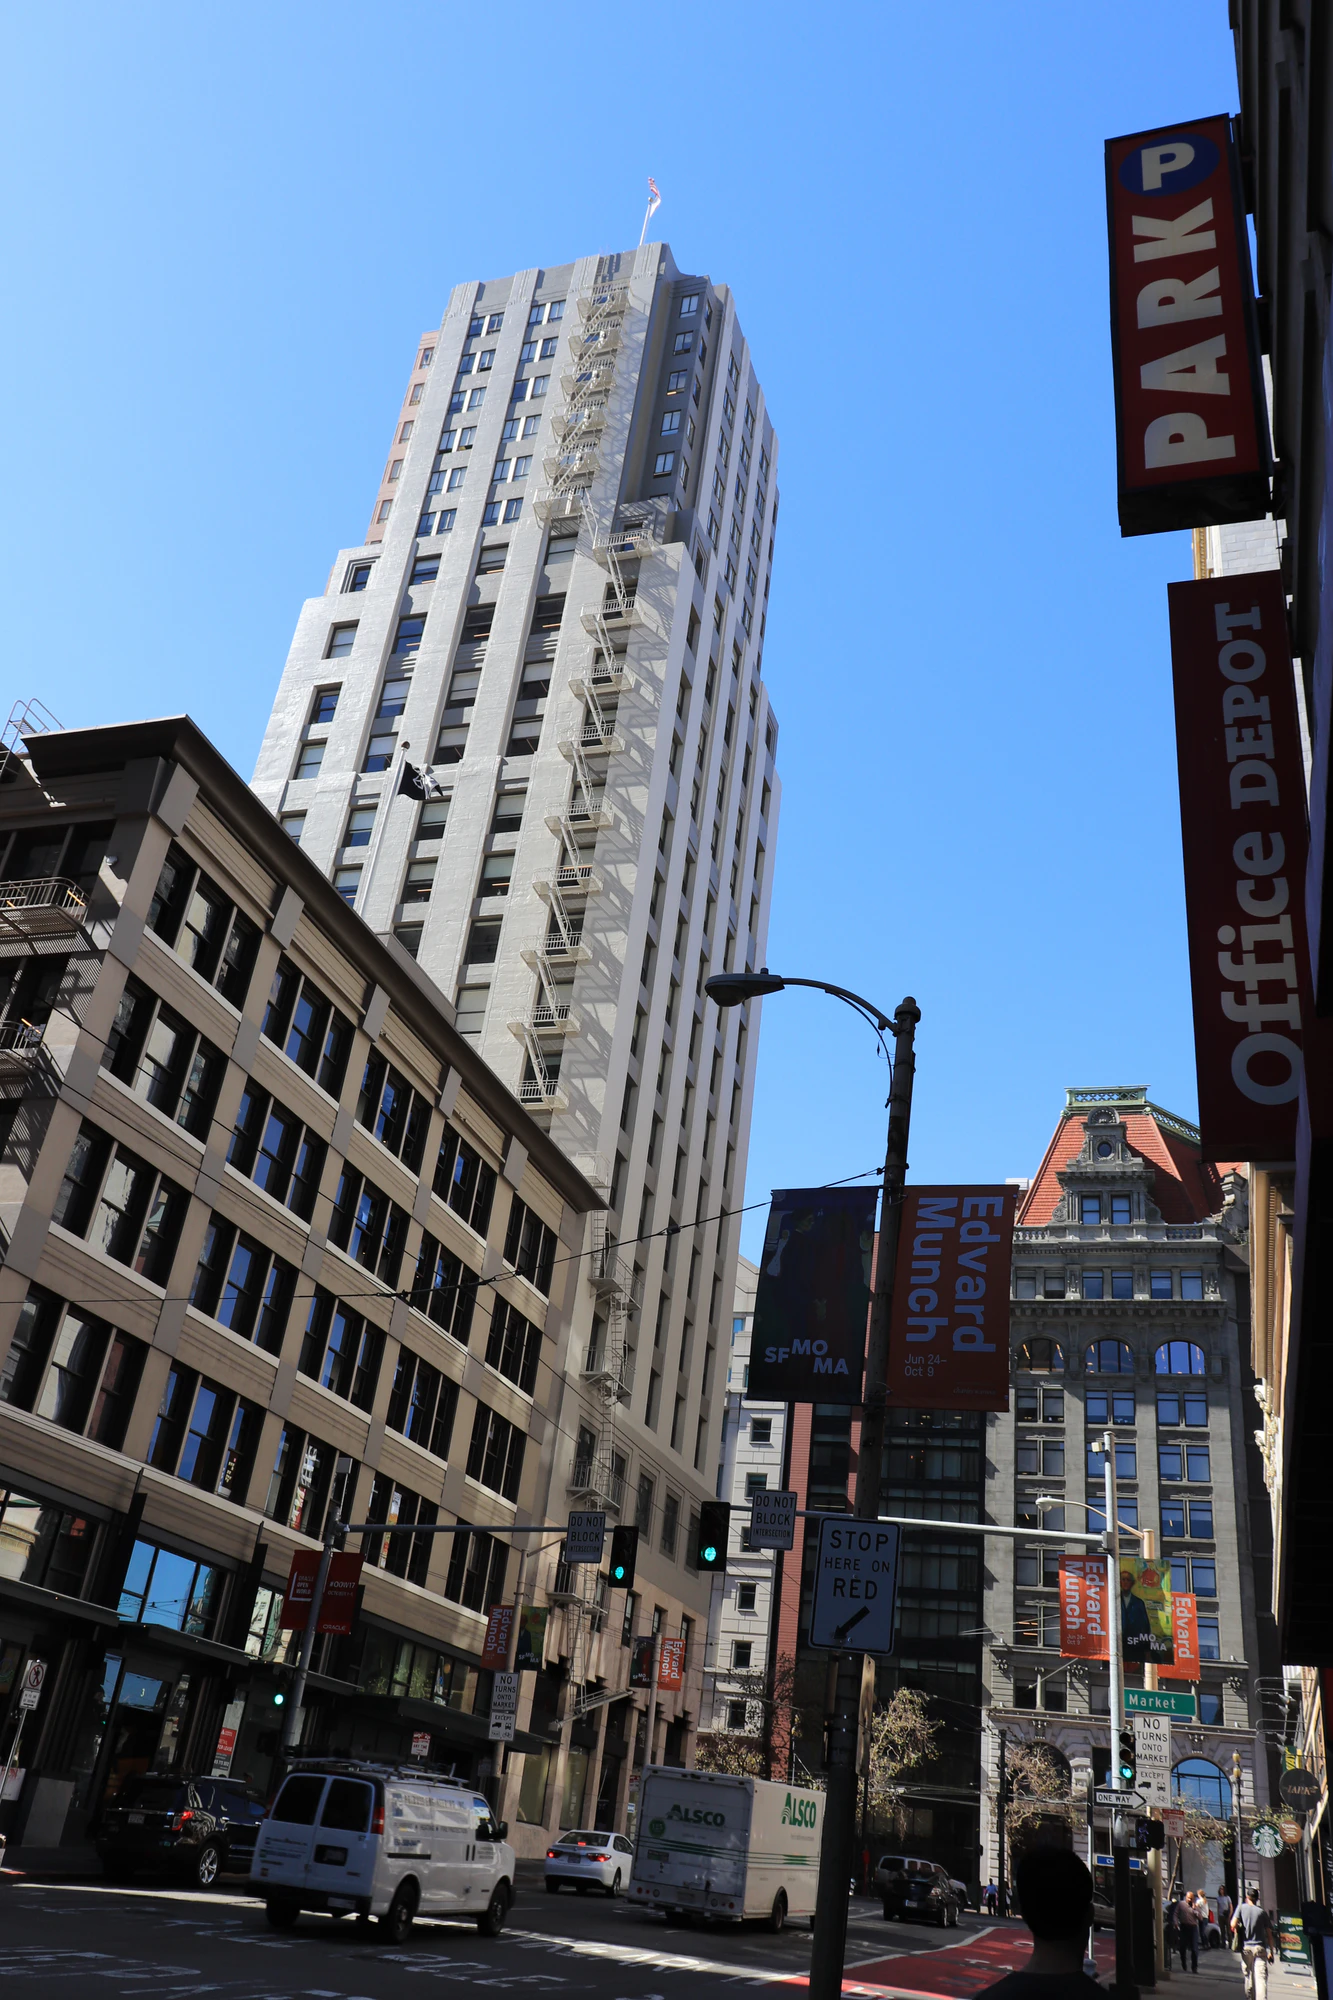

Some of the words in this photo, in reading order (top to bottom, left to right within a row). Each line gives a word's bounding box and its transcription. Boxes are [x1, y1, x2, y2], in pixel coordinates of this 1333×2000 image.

[1141, 142, 1195, 191] P
[1131, 197, 1236, 469] PARK
[1214, 602, 1280, 810] DEPOT
[1217, 831, 1304, 1105] Office
[906, 1197, 958, 1342] Munch
[953, 1196, 1004, 1352] Edvard
[904, 1353, 924, 1365] Jun
[904, 1366, 923, 1377] Oct
[927, 1366, 935, 1377] 9
[756, 1495, 770, 1507] DO
[773, 1497, 795, 1509] NOT
[571, 1516, 583, 1526] DO
[586, 1517, 604, 1527] NOT
[756, 1513, 791, 1525] BLOCK
[571, 1531, 600, 1542] BLOCK
[753, 1528, 791, 1538] INTERSECTION
[830, 1530, 888, 1552] STOP
[824, 1557, 860, 1571] HERE
[871, 1560, 890, 1573] ON
[833, 1578, 877, 1600] RED
[1065, 1561, 1085, 1629] Munch
[1086, 1562, 1106, 1636] Edvard
[322, 1623, 346, 1631] ORACLE
[486, 1608, 502, 1651] Munch
[497, 1608, 513, 1654] Edvard
[1175, 1597, 1195, 1658] Edvard
[661, 1641, 673, 1676] Munch
[670, 1641, 683, 1679] Edvard
[500, 1676, 512, 1684] NO
[495, 1686, 516, 1694] TURNS
[1128, 1694, 1176, 1710] Market
[1143, 1718, 1160, 1730] NO
[1136, 1731, 1168, 1742] TURNS
[1142, 1743, 1162, 1751] ONTO
[1136, 1753, 1168, 1763] MARKET
[1141, 1771, 1164, 1779] EXCEPT
[1098, 1794, 1112, 1802] ONE
[1114, 1795, 1130, 1804] WAY
[666, 1804, 725, 1827] ALSCO
[781, 1792, 816, 1828] ALSCO
